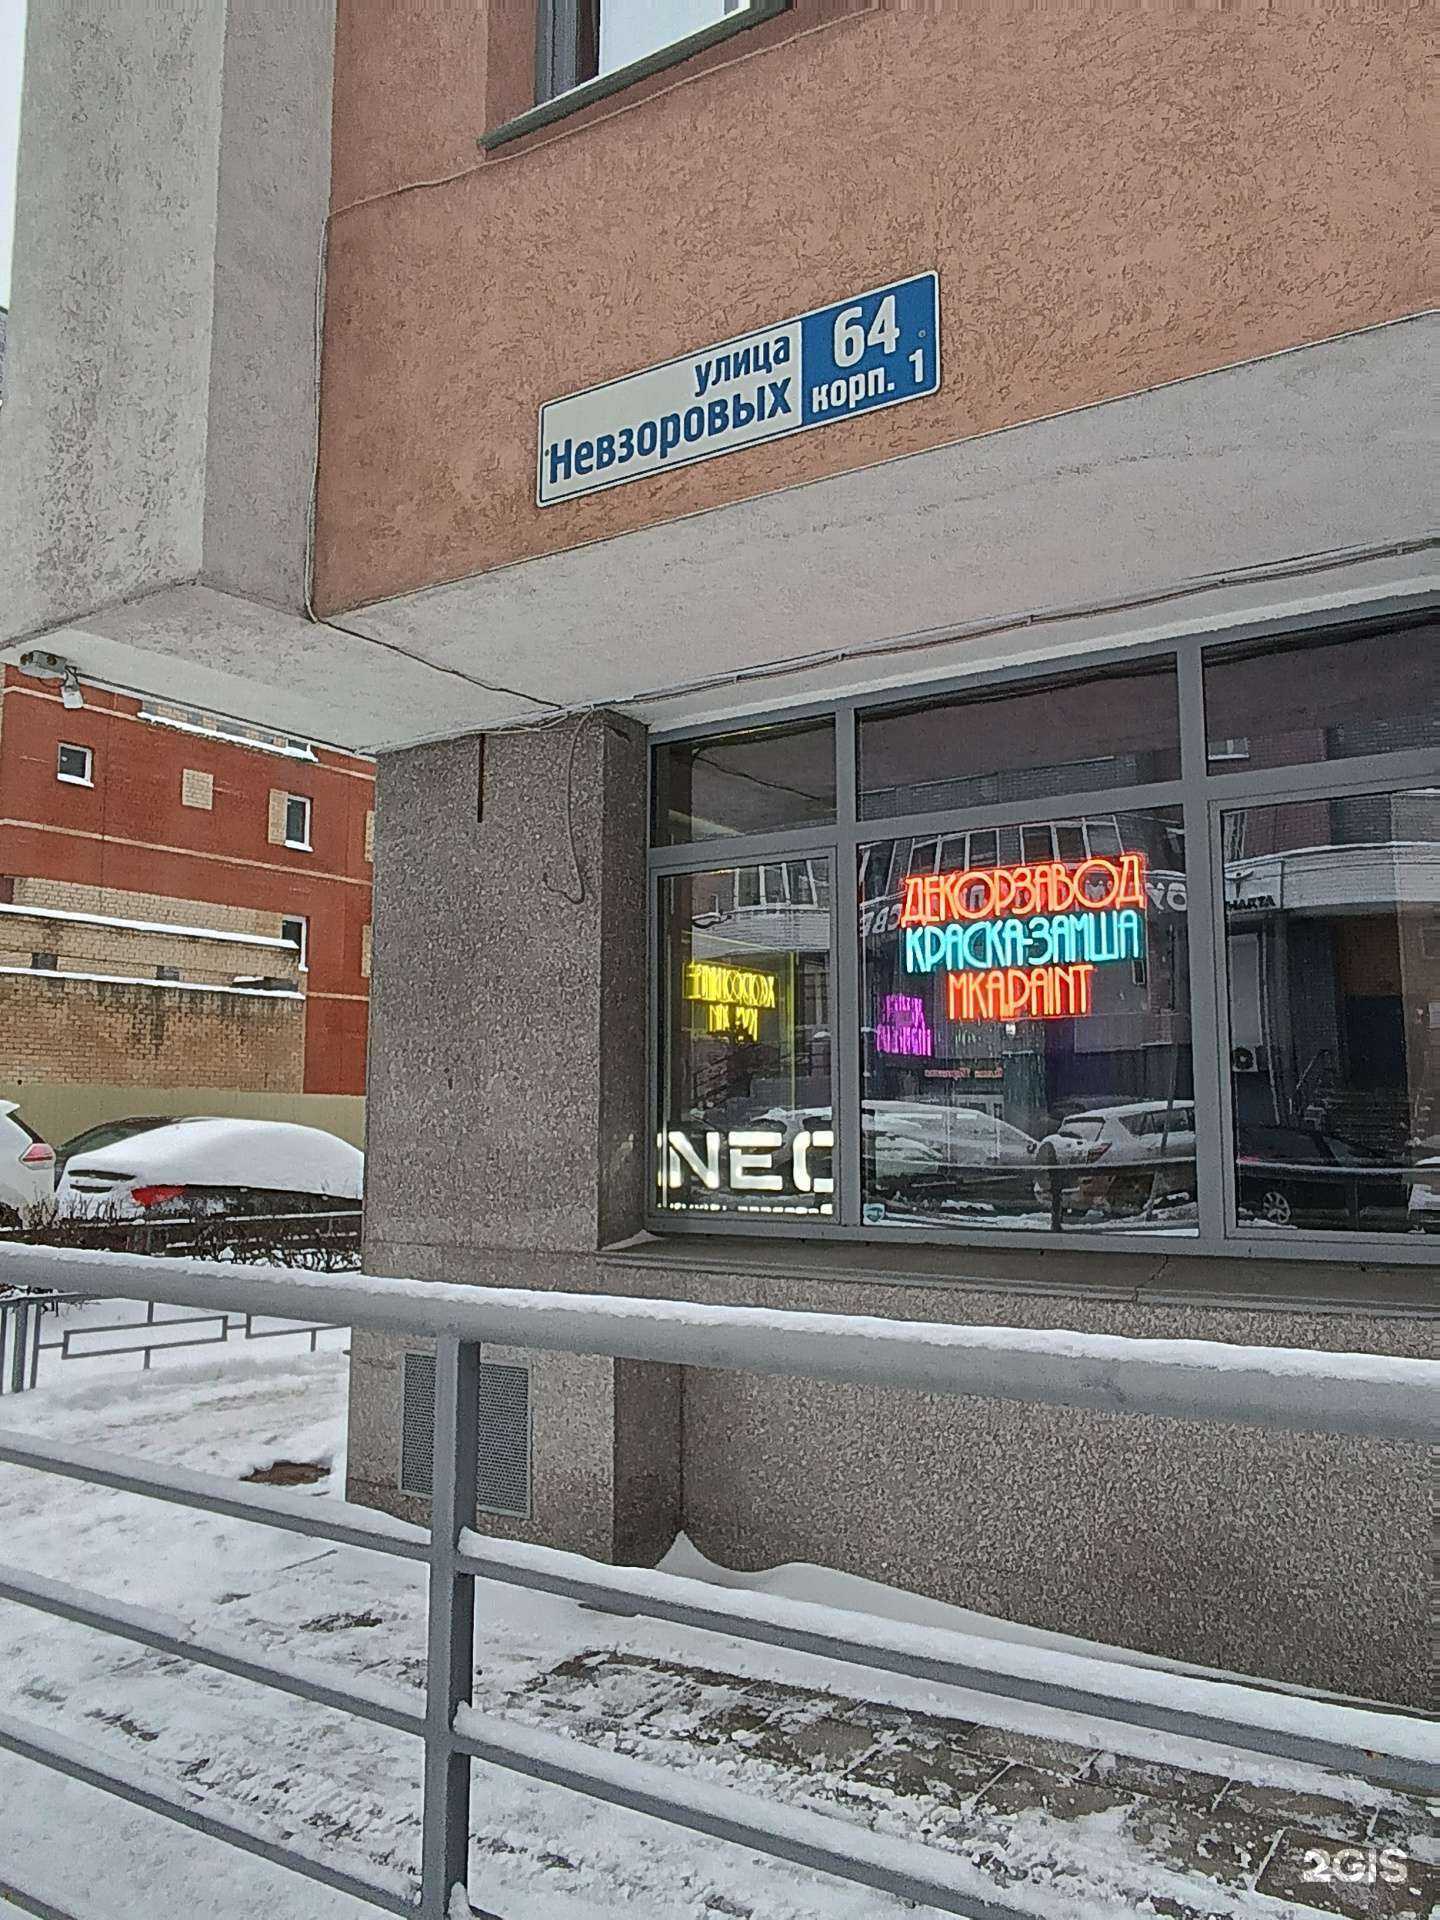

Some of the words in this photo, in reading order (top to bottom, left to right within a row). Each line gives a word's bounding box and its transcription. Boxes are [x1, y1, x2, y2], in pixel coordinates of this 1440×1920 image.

[834, 295, 900, 367] 64
[694, 336, 790, 397] улица
[812, 367, 895, 413] корп.
[908, 348, 924, 383] 1
[549, 376, 792, 484] Невзоровых
[901, 853, 1145, 927] ДЕКОРЗАВОД
[905, 910, 1140, 973] КРАСКА-ЗАМША
